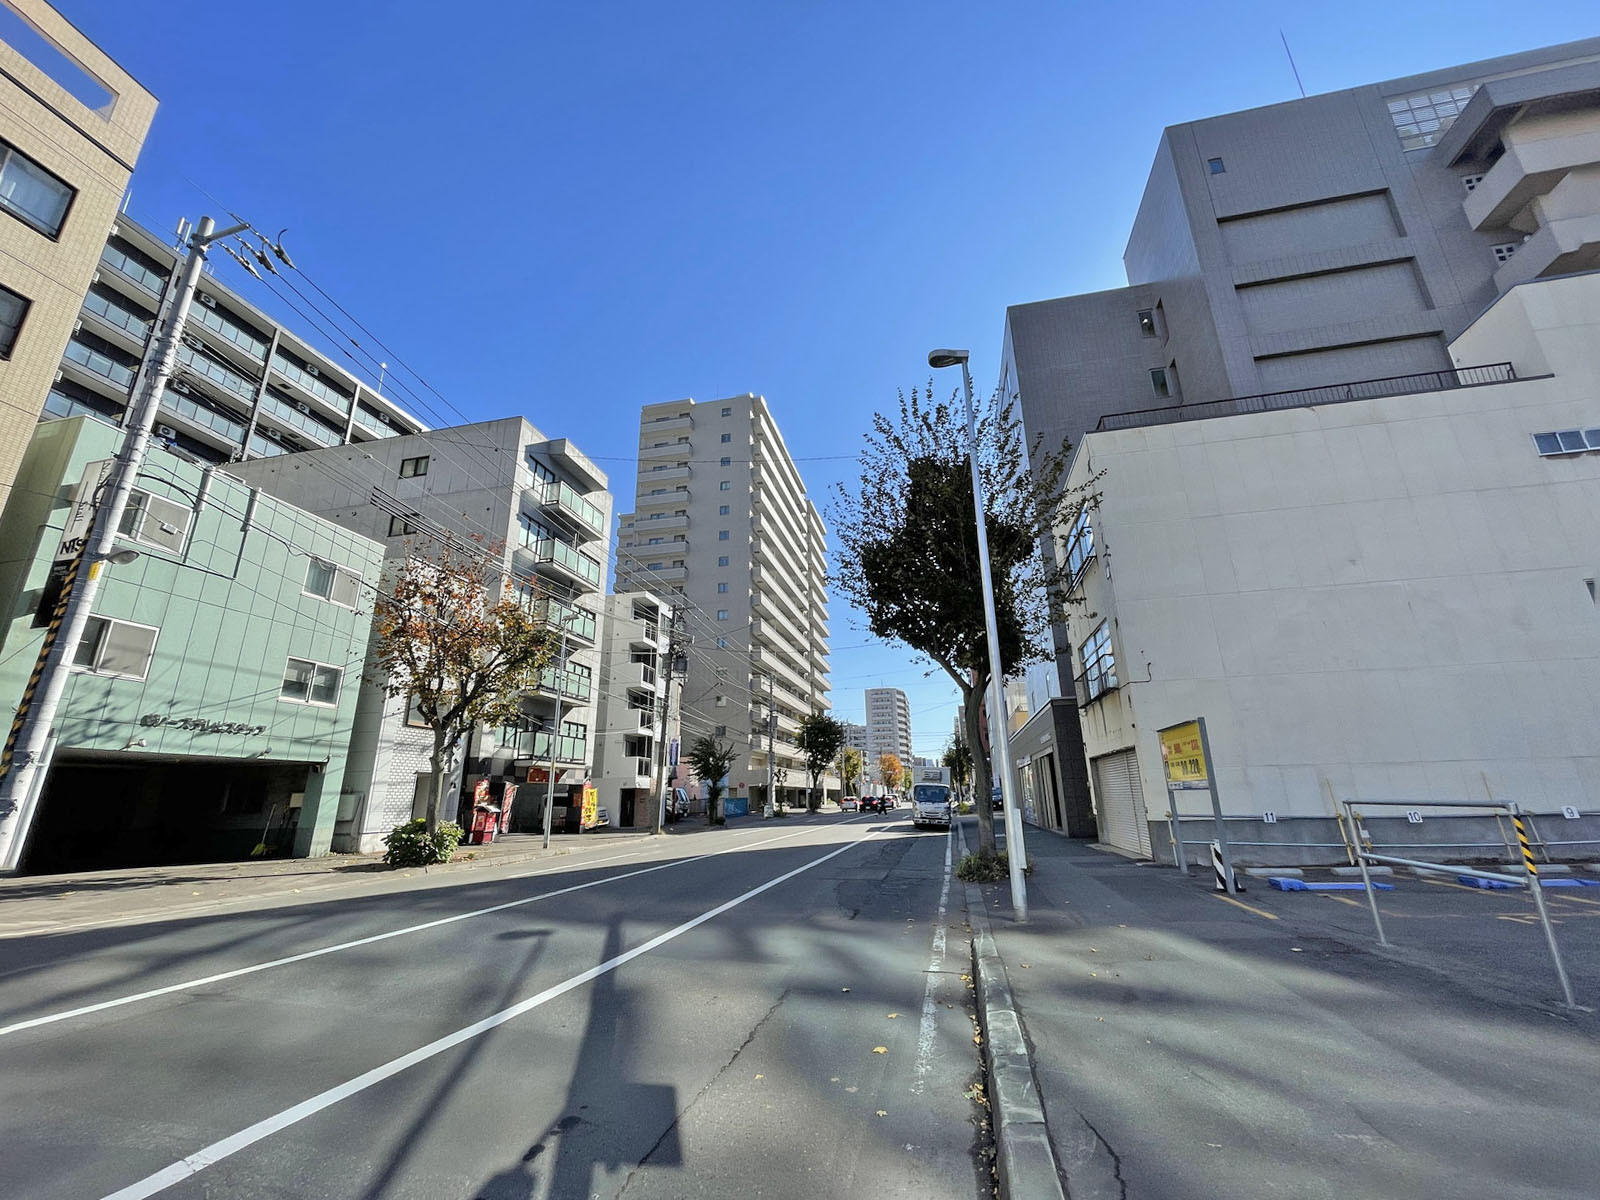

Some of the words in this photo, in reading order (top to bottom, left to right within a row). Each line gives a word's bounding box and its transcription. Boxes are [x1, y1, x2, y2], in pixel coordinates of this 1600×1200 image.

[60, 537, 83, 555] NTS
[1264, 812, 1275, 823] 11
[1409, 811, 1421, 822] 10
[1566, 807, 1574, 818] 9
